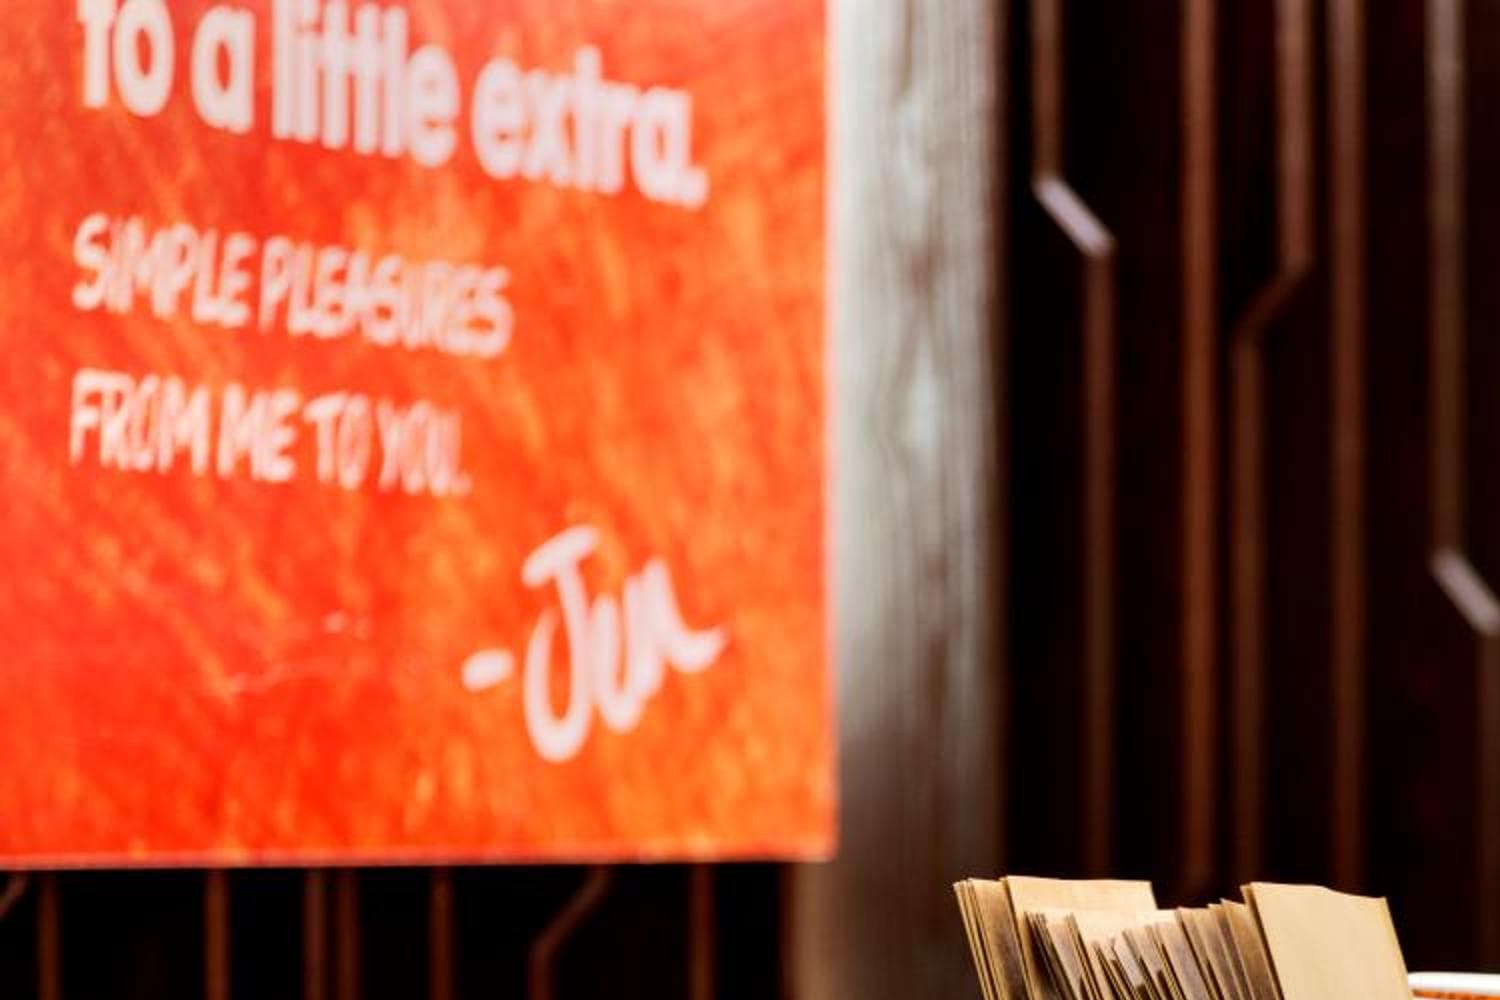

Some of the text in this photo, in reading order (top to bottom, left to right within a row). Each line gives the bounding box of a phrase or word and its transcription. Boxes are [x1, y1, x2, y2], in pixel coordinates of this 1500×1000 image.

[77, 0, 709, 211] to a little extra.
[71, 212, 514, 360] SIMPLE PLEASURES
[69, 366, 211, 480] FROM
[217, 381, 300, 483] ME
[303, 391, 373, 492] TO
